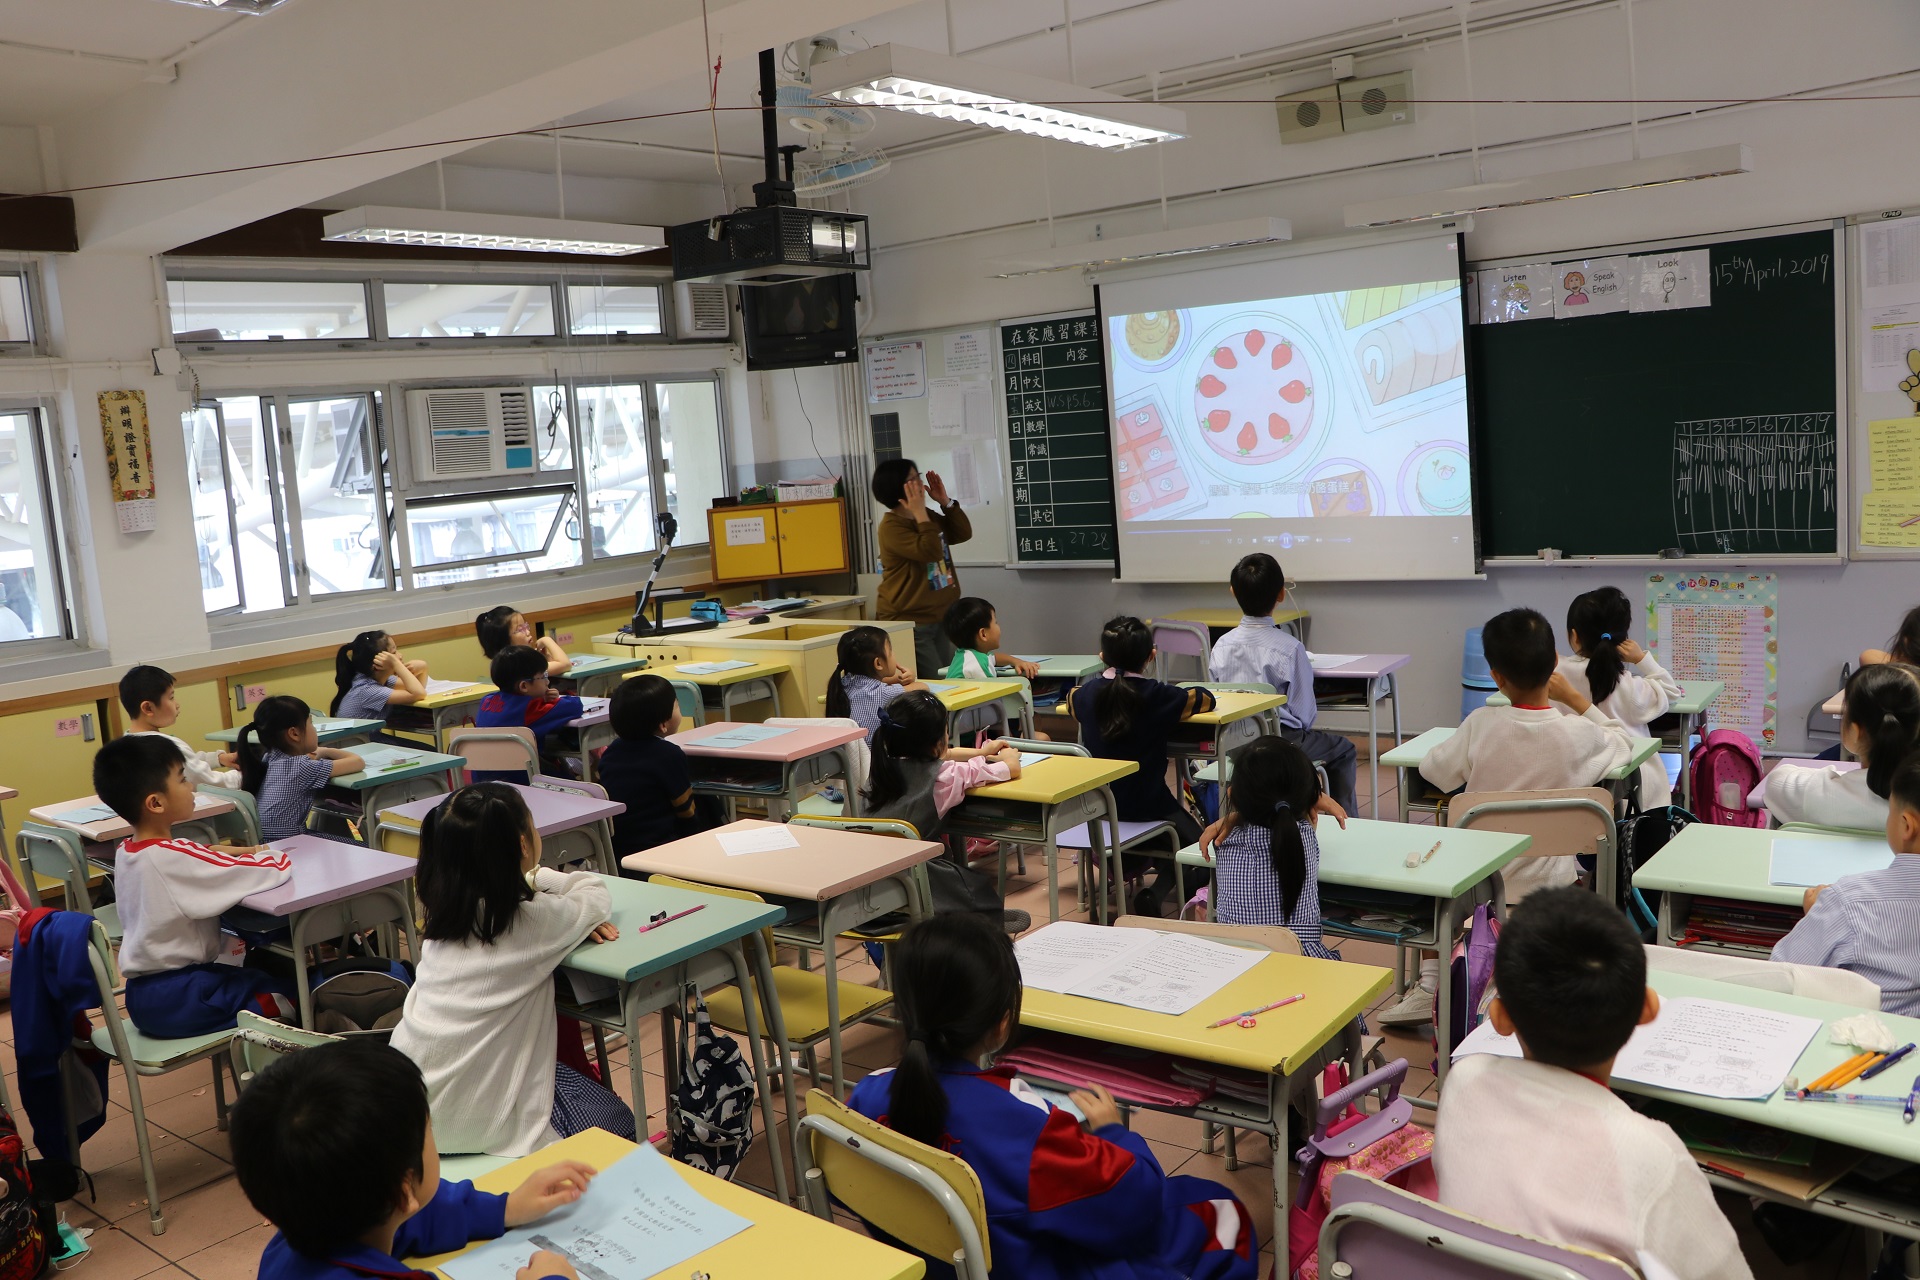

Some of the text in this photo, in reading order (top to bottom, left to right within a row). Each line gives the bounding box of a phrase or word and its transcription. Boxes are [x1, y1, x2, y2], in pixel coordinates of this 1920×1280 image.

[1657, 259, 1679, 268] Look
[1790, 254, 1829, 284] 2019
[1503, 274, 1527, 282] Listen
[1593, 272, 1615, 282] Speak
[1592, 283, 1617, 294] English
[1021, 352, 1041, 366] 科目
[1066, 347, 1088, 362] 內容
[1008, 375, 1018, 391] 月
[1022, 375, 1042, 389] 中文
[1024, 398, 1044, 412] 英文
[1012, 421, 1021, 434] 日
[1025, 420, 1046, 433] 數學
[1695, 422, 1705, 431] 2
[1712, 420, 1722, 434] 3
[1726, 419, 1738, 430] 4
[1745, 418, 1756, 433] 5
[1761, 416, 1774, 431] 6
[1779, 417, 1791, 432] 7
[1800, 415, 1812, 431] 8
[1818, 412, 1831, 433] 9
[1027, 443, 1048, 457] 常識
[1014, 465, 1027, 481] 星
[1015, 487, 1028, 503] 期
[1032, 509, 1052, 523] 其它
[1019, 537, 1058, 553] 值日生
[247, 688, 266, 699] 英文
[57, 719, 79, 731] 數學
